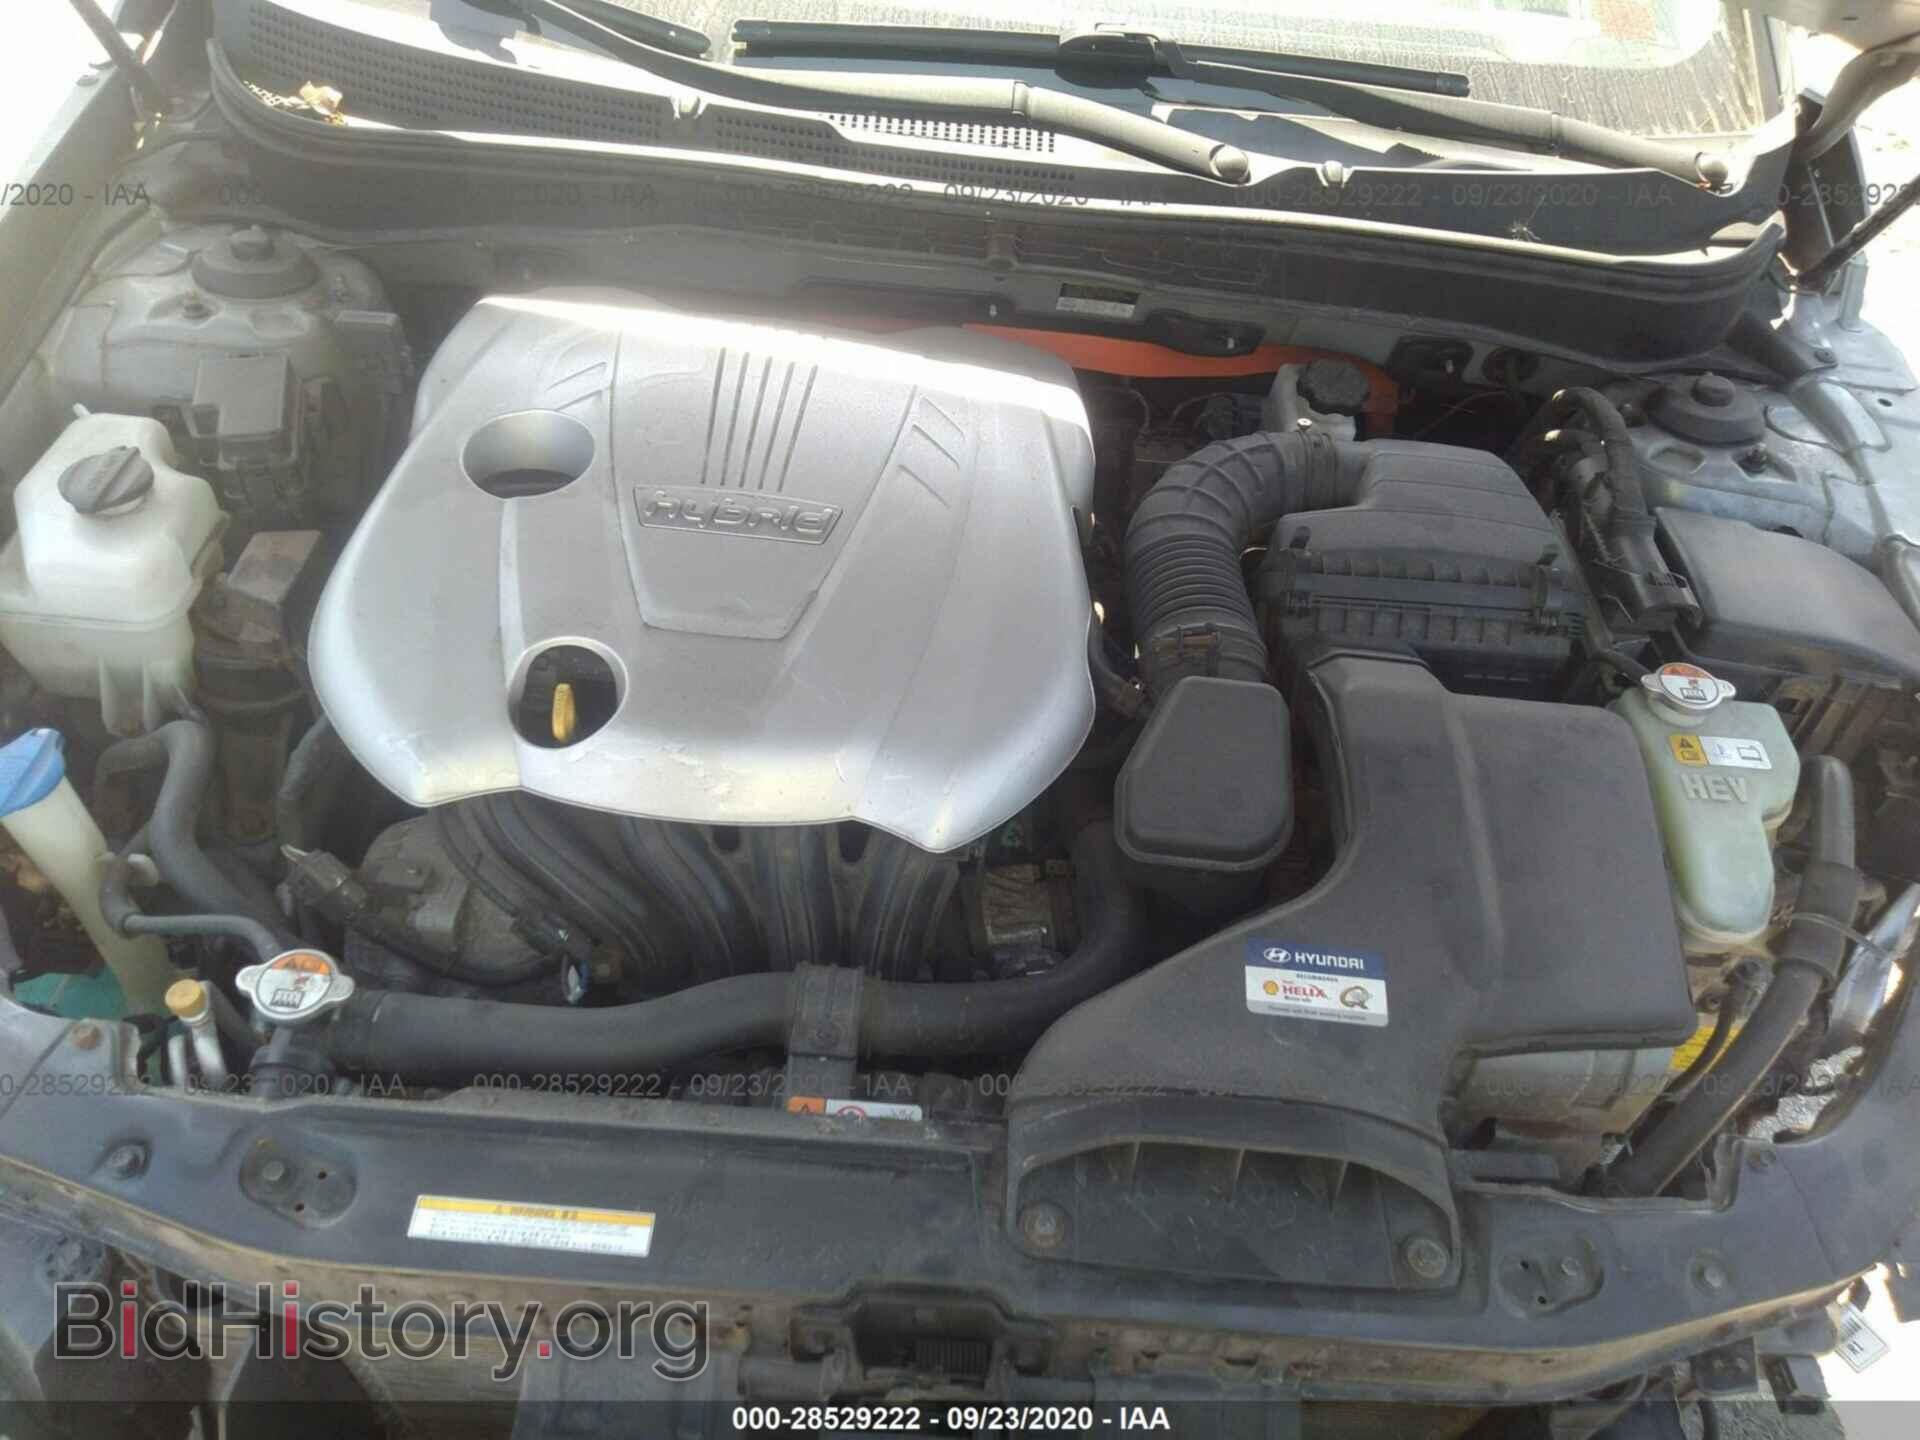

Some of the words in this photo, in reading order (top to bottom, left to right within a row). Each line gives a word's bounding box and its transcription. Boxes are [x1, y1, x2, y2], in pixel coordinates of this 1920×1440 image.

[1680, 773, 1747, 803] HEV
[1294, 951, 1365, 969] HYUNDAI
[1282, 985, 1326, 999] HELIX
